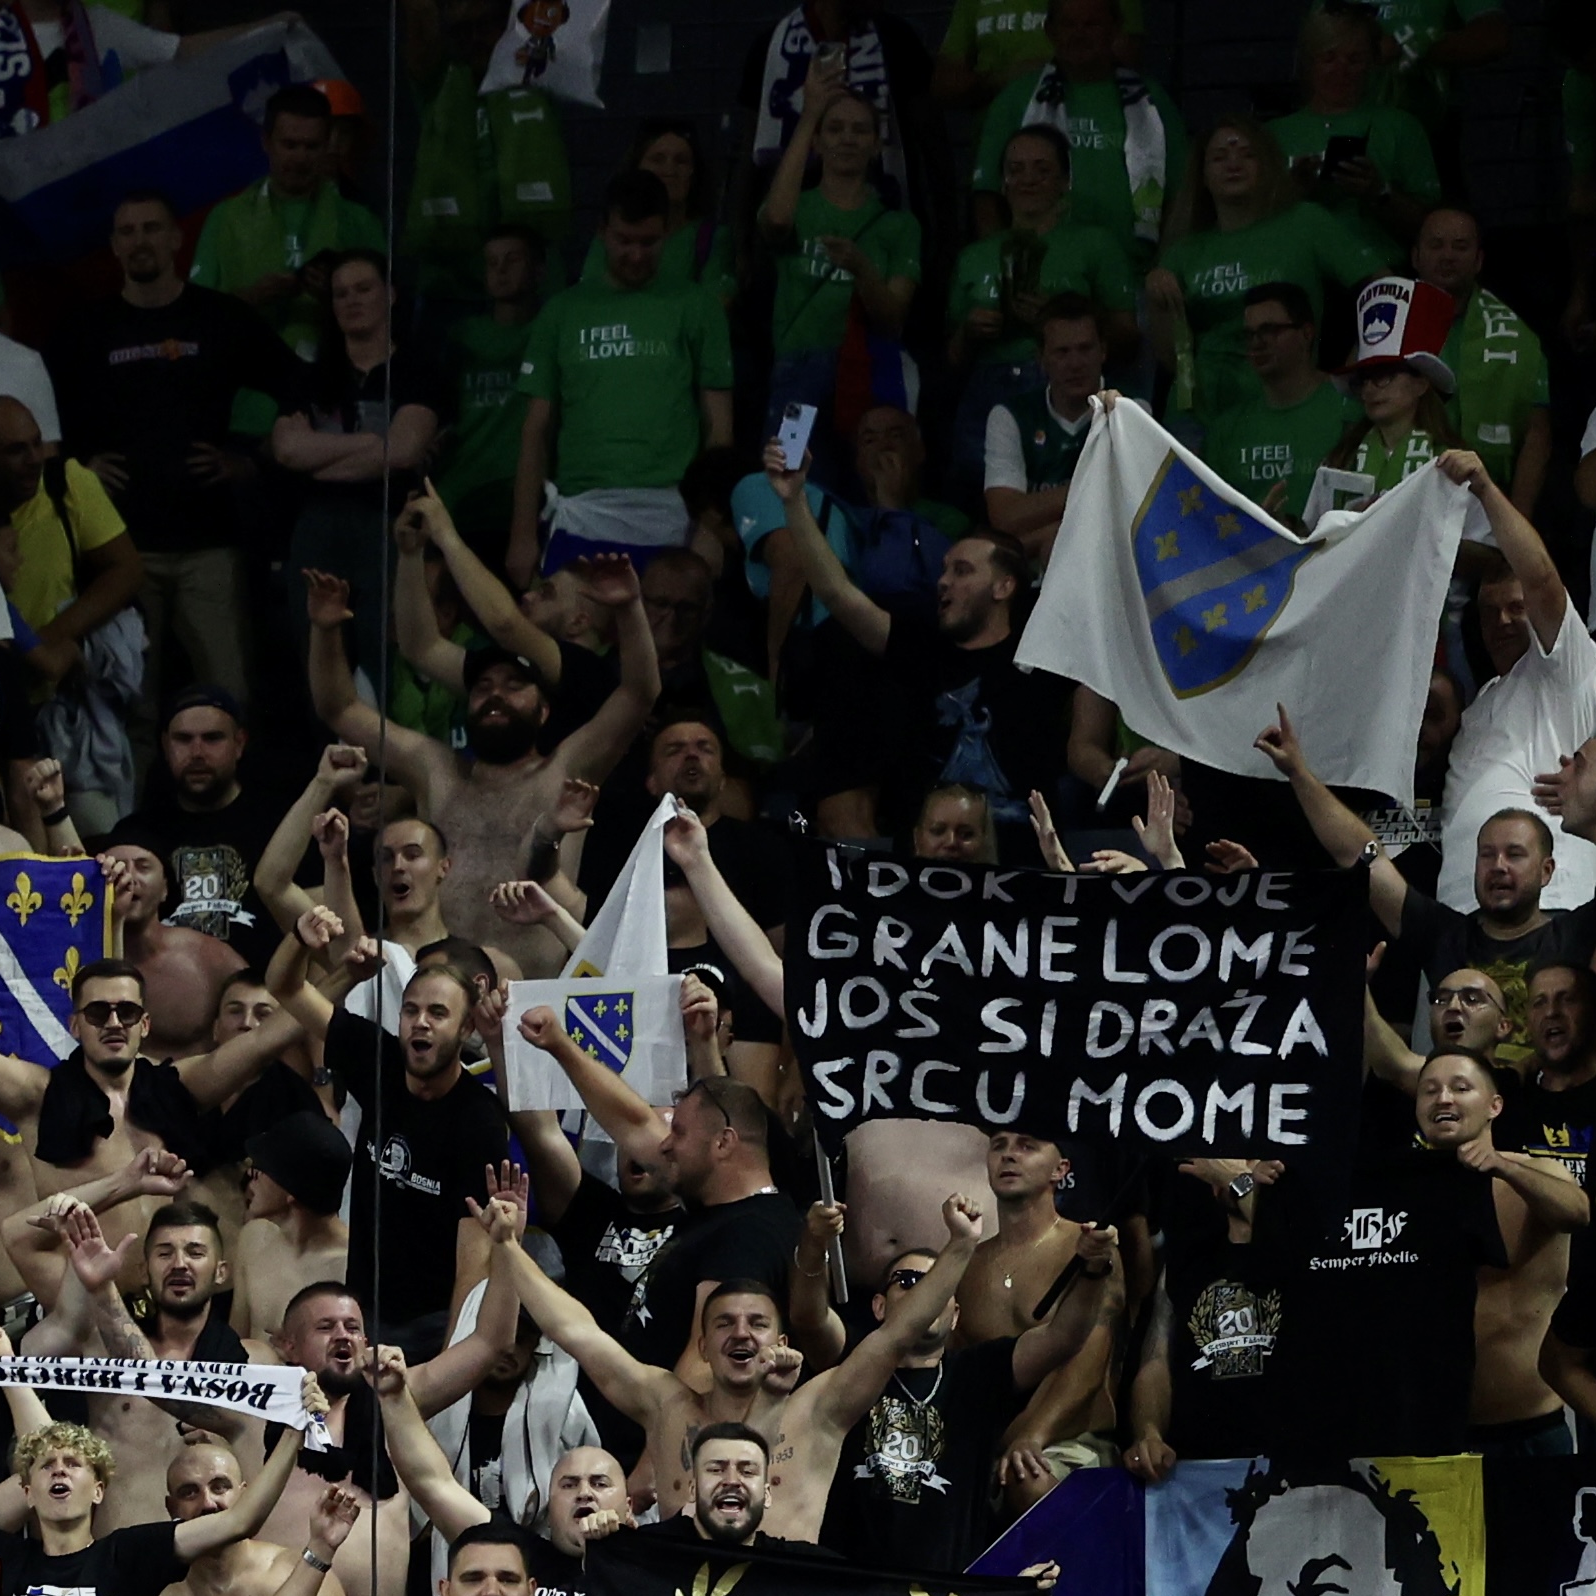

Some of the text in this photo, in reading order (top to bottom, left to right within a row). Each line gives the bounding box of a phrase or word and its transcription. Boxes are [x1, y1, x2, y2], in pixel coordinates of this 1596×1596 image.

[591, 324, 632, 341] FEEL
[185, 874, 219, 899] 20
[866, 860, 1017, 902] DOK
[808, 904, 1317, 984] GRANE LOME
[798, 974, 1331, 1060] JOŠ SI DRAŽA
[811, 1050, 1314, 1147] SRCU MOME
[1308, 1250, 1420, 1271] Semper Fidelis
[1218, 1306, 1253, 1336] 20
[181, 1361, 249, 1376] JEDNA
[157, 1374, 276, 1411] BOSNA
[886, 1433, 919, 1461] 20
